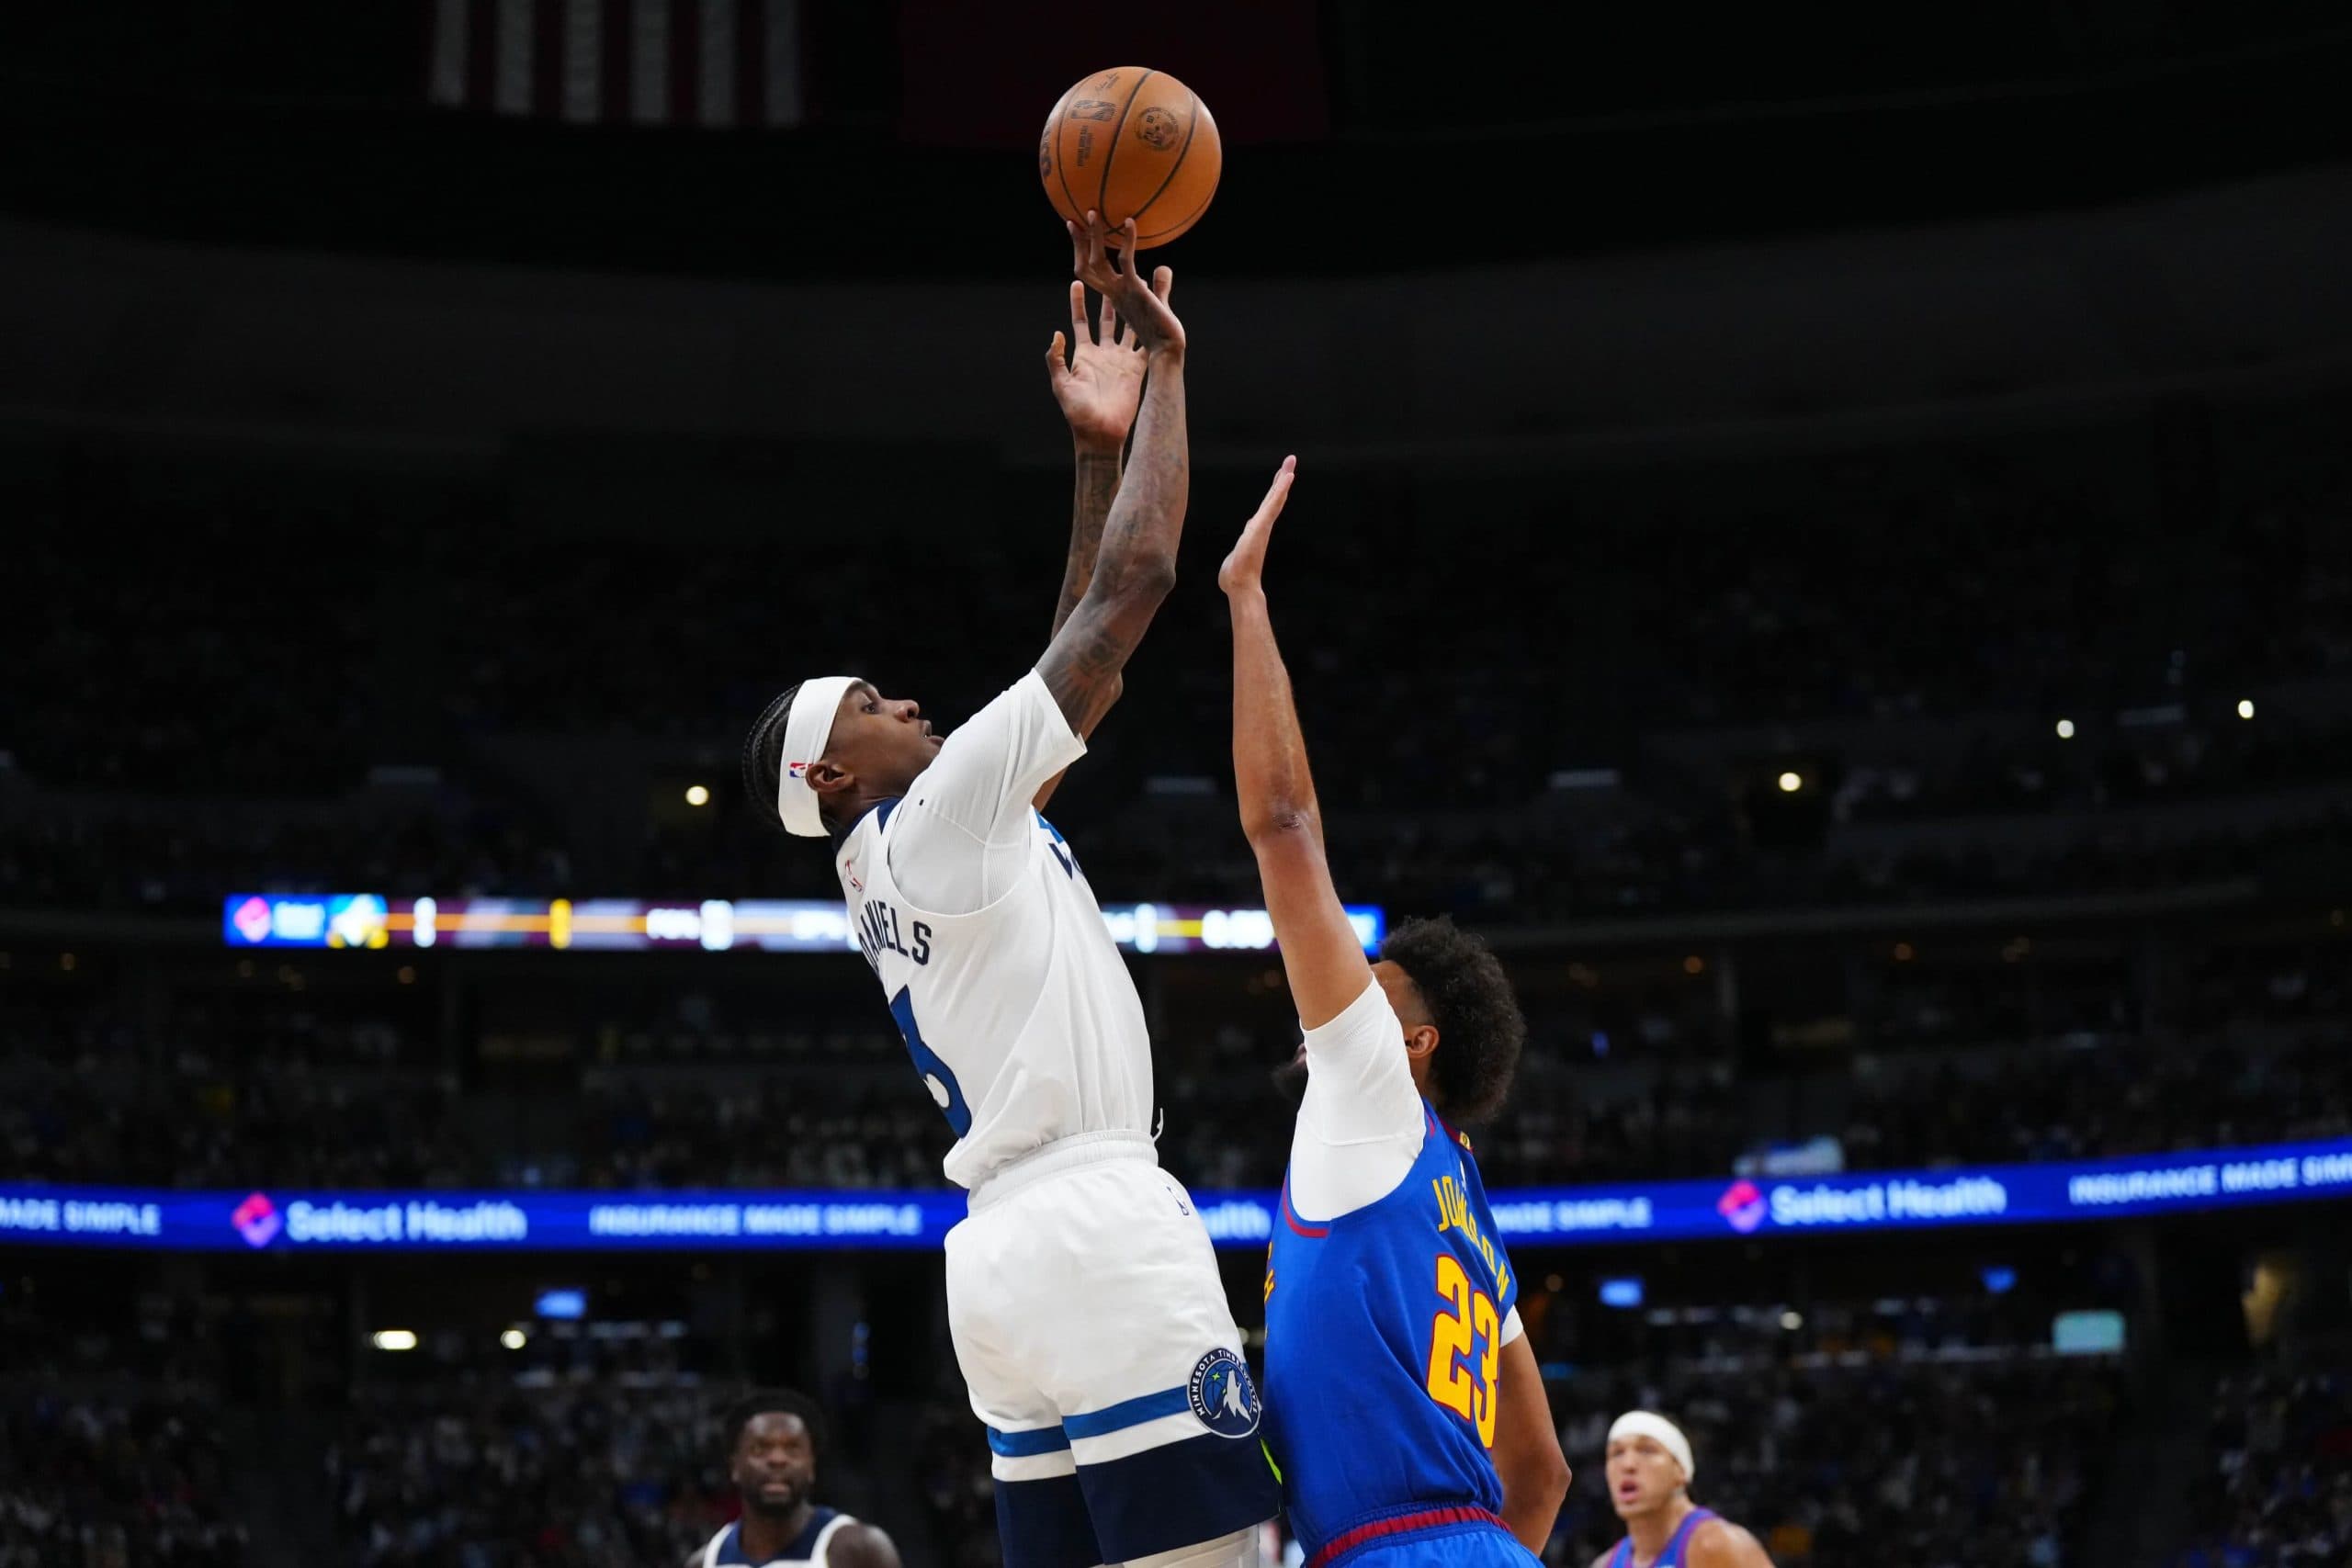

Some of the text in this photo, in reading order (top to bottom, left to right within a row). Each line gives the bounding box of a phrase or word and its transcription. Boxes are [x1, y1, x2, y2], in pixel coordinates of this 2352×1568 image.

[1771, 1176, 2007, 1226] Select Health
[2069, 1153, 2352, 1204] INSURANCE MADE SIM
[63, 1200, 161, 1235] SIMPLE
[287, 1200, 527, 1241] Select Health
[1556, 1197, 1652, 1232] SIMPLE
[1428, 1252, 1500, 1450] 23
[1190, 1354, 1216, 1416] MINNESOTA
